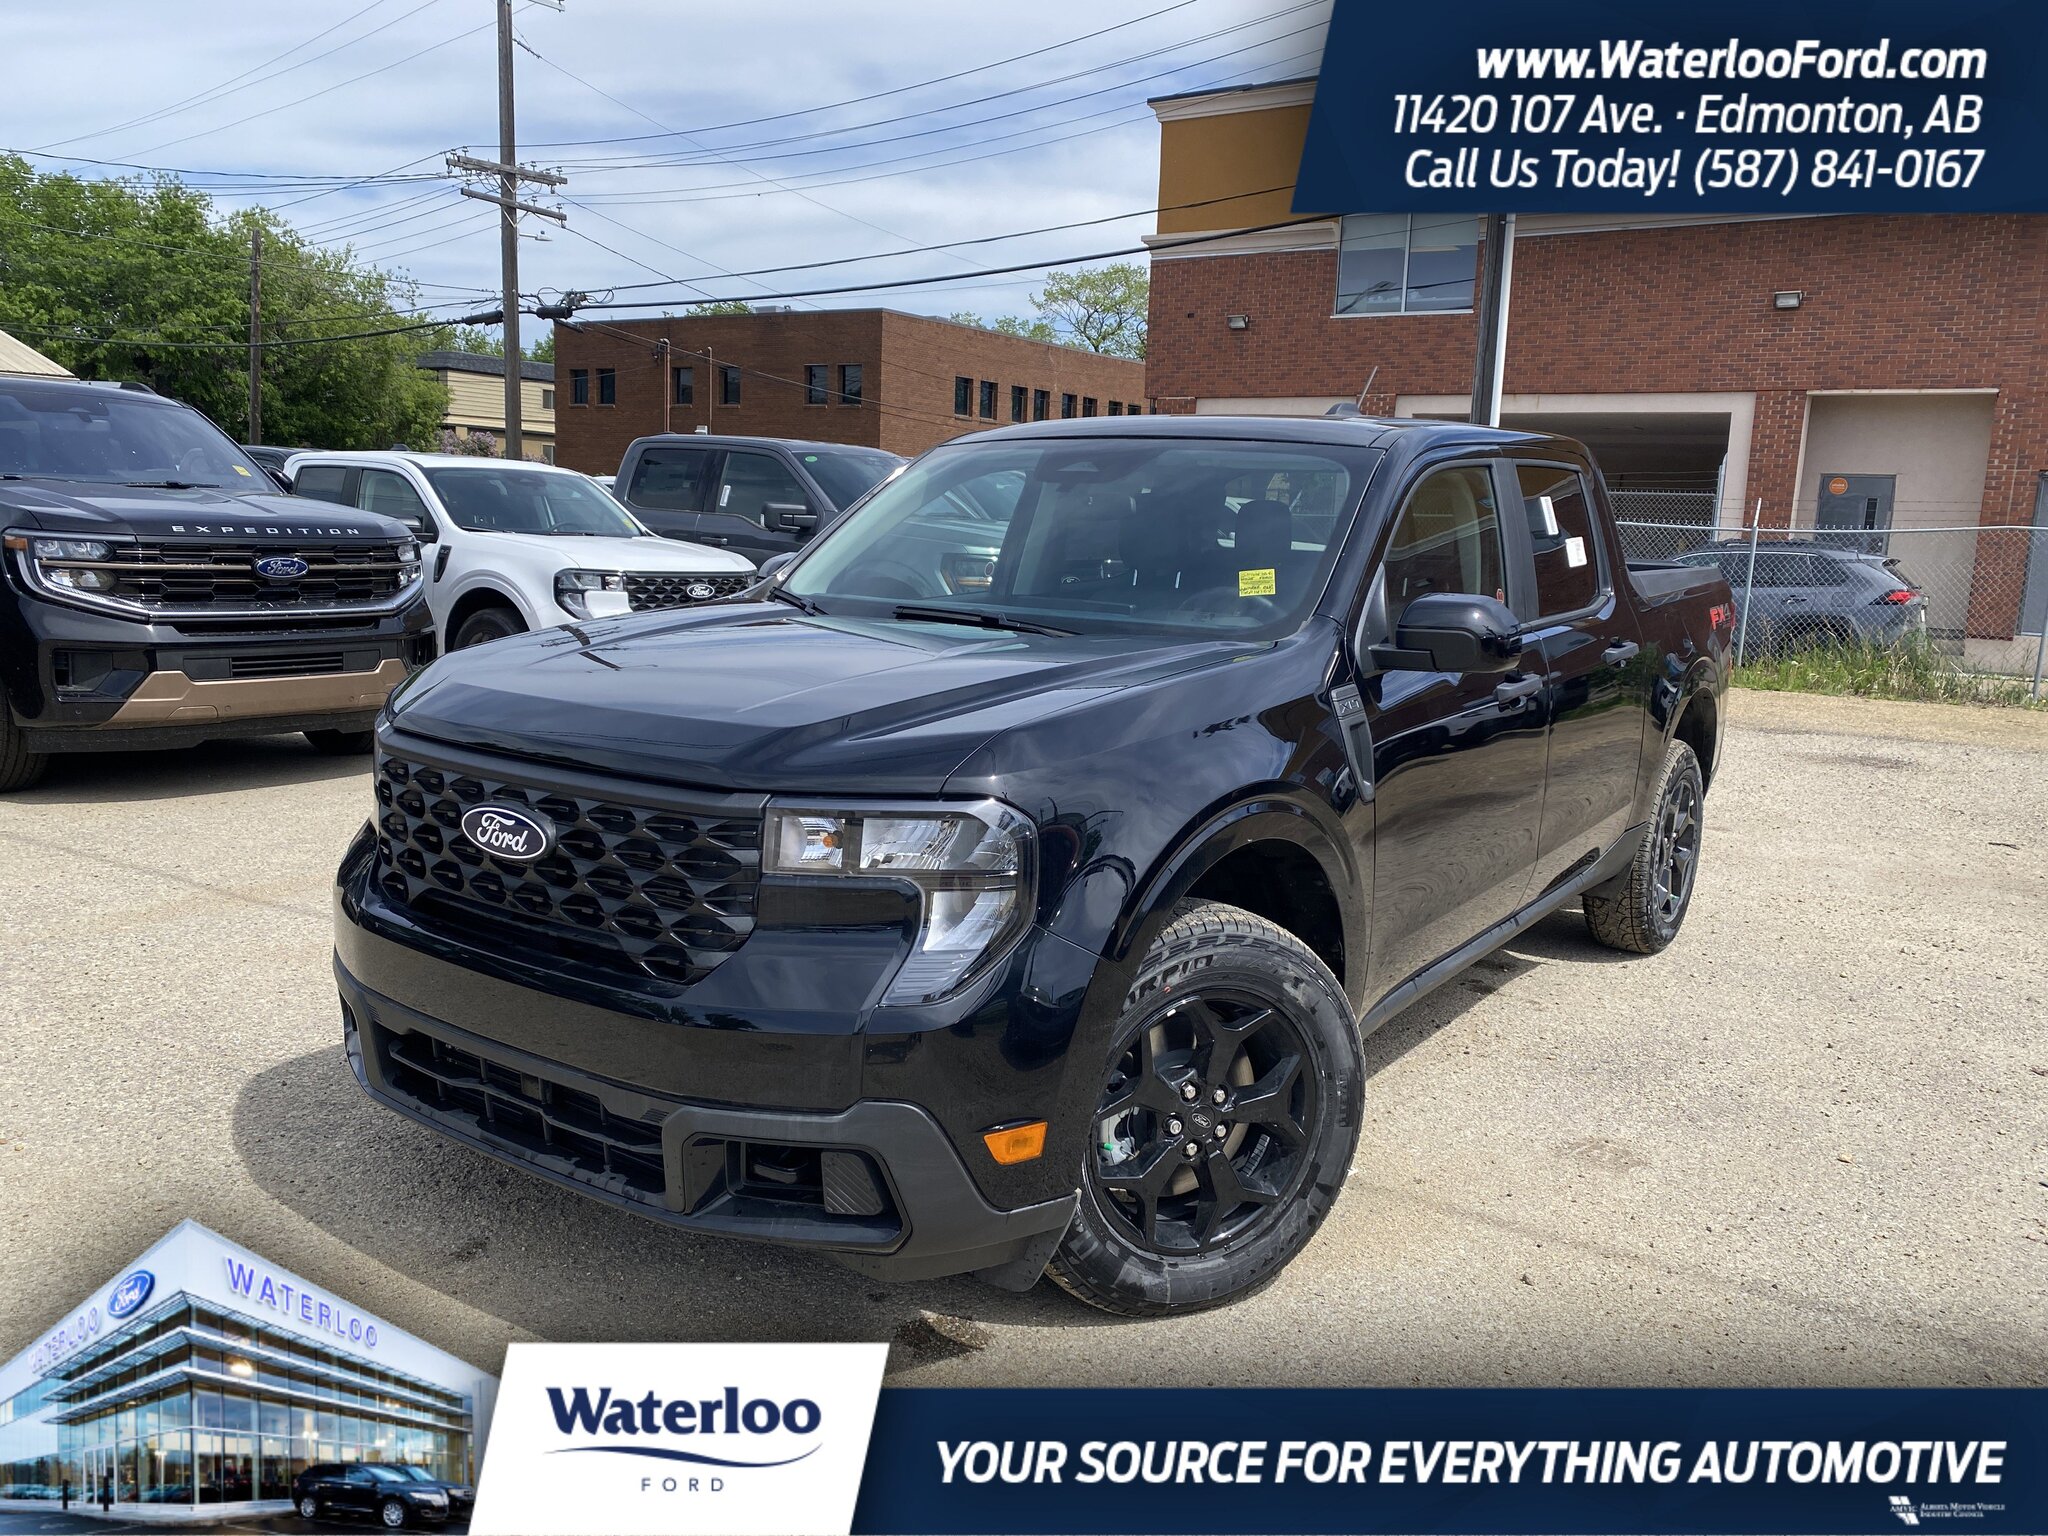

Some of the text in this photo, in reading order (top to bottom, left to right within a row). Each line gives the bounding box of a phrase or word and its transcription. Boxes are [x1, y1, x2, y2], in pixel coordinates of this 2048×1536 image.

[171, 525, 360, 535] EXPEDITION
[266, 560, 299, 575] Ford
[692, 585, 710, 595] Ford
[476, 813, 529, 853] Ford
